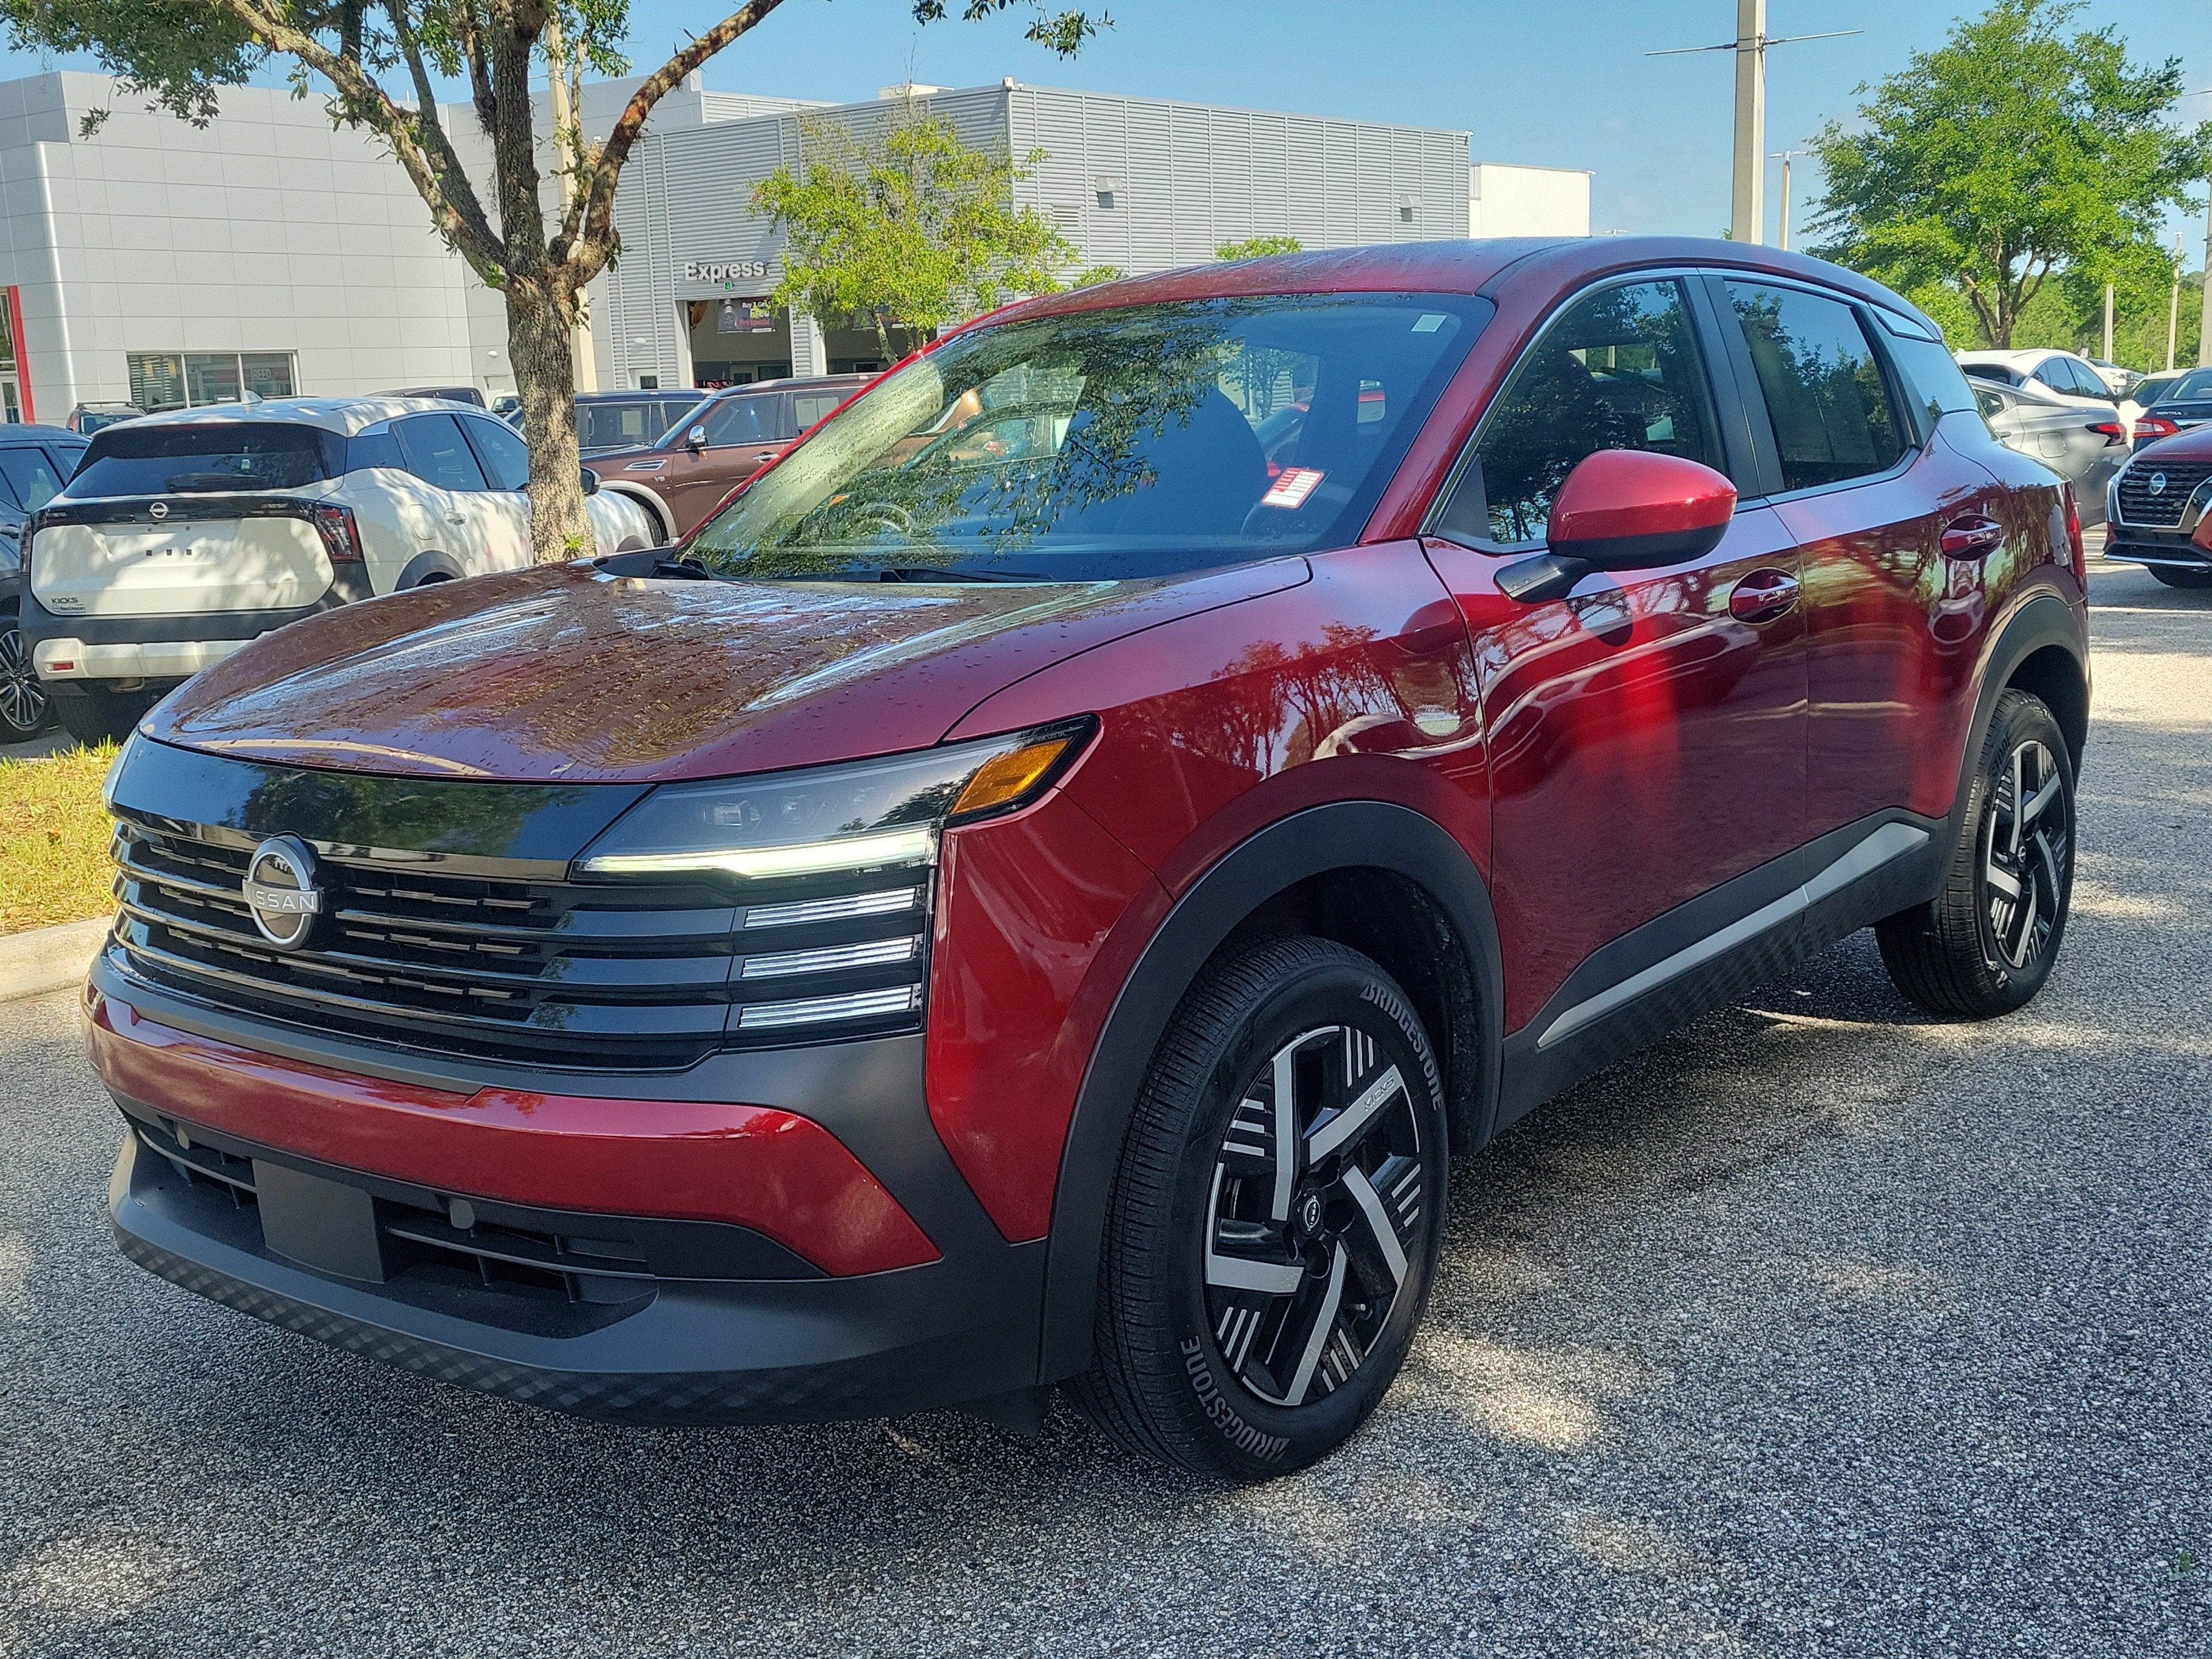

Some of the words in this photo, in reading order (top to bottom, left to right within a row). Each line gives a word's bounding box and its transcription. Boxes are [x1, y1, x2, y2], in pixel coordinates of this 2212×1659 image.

[685, 261, 765, 284] Express
[245, 885, 315, 910] NISSAN
[1359, 983, 1442, 1111] BRIDGESTONE
[1364, 1074, 1395, 1112] KICKS
[1180, 1335, 1290, 1464] BRIDGESTONE
